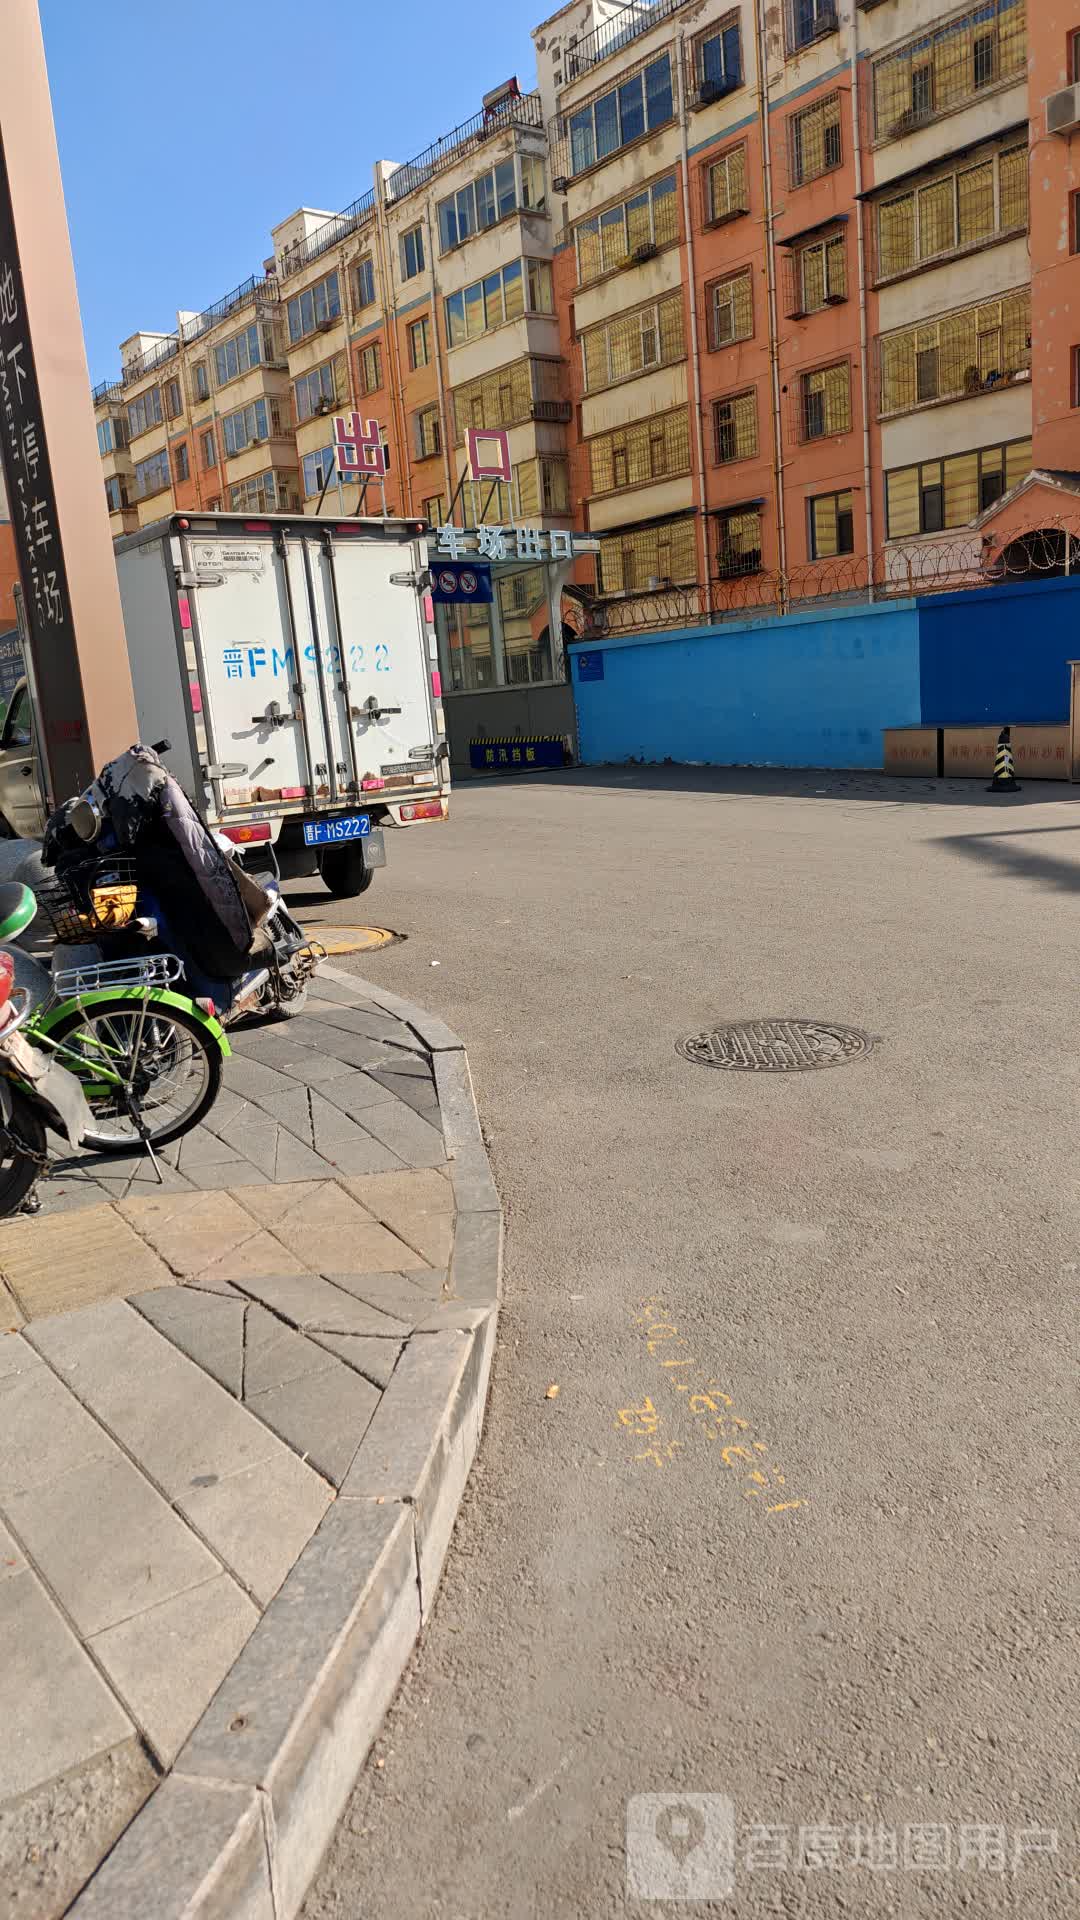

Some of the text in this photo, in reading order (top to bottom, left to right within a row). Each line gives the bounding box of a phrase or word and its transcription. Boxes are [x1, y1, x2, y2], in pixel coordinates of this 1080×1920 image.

[0, 261, 64, 625] 地下停车场
[333, 411, 513, 483] 出口
[437, 523, 573, 560] 车场出口
[485, 747, 536, 763] 防汛挡板
